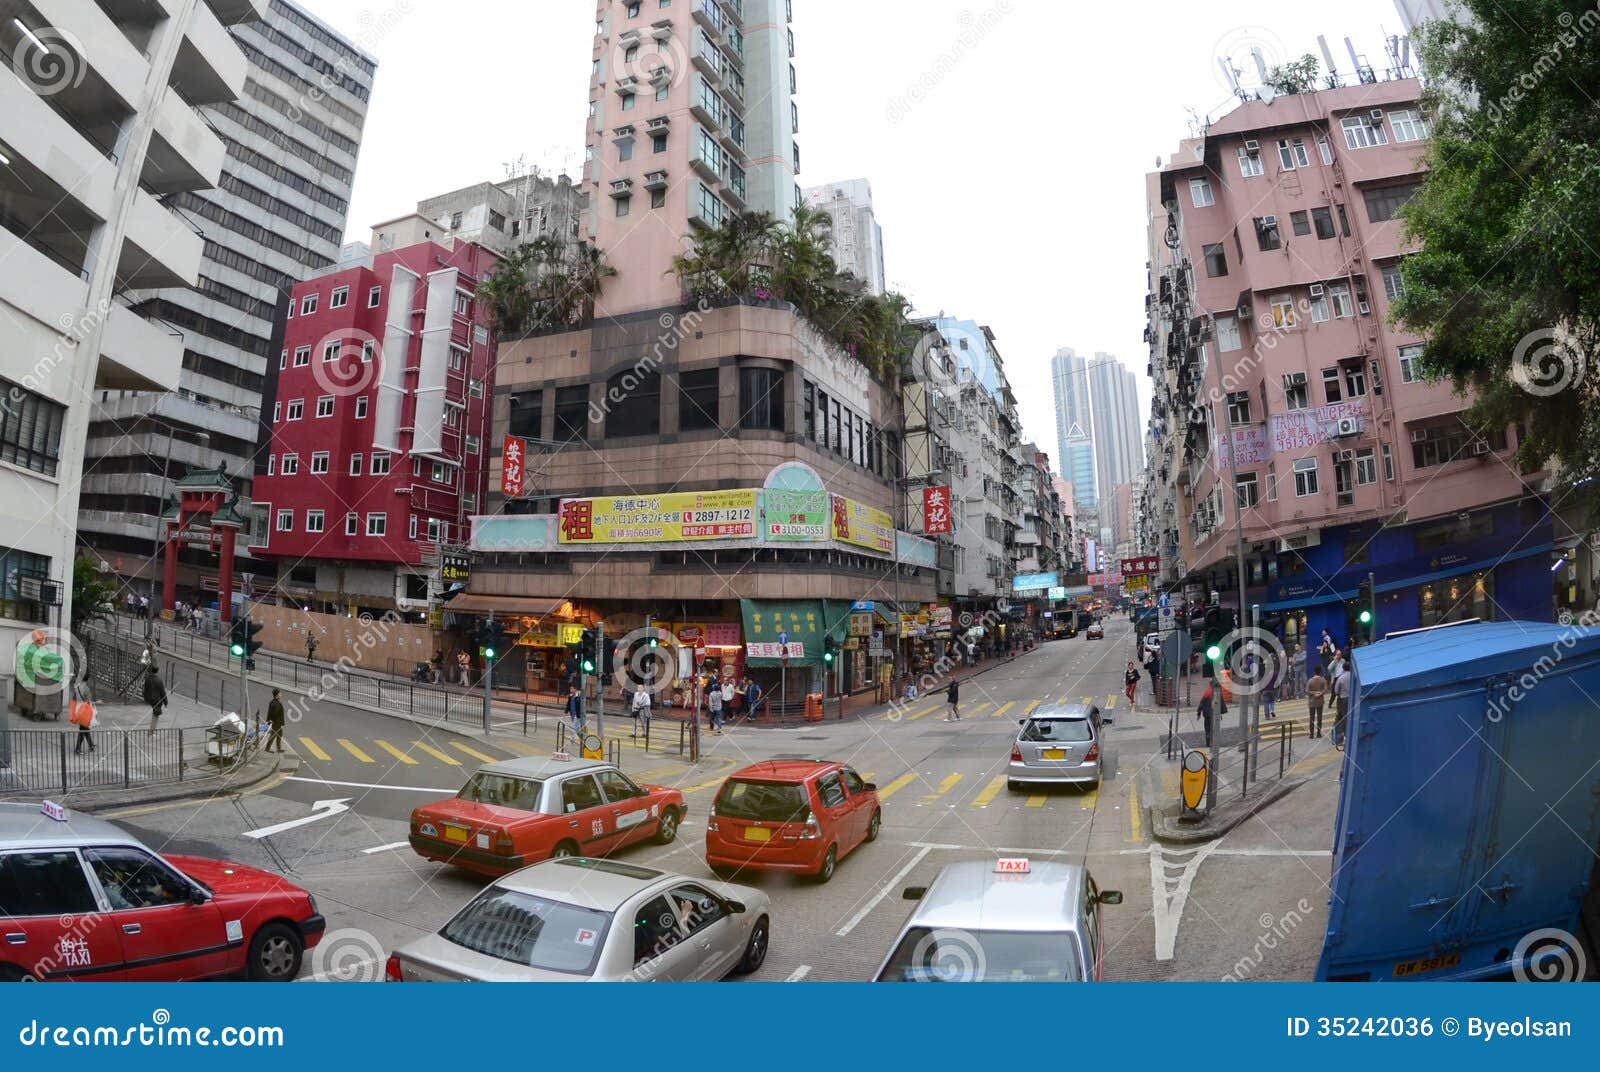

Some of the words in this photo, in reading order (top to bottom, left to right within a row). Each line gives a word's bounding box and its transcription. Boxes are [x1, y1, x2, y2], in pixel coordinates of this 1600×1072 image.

[506, 440, 521, 482] 安記
[613, 498, 660, 512] 海德中心
[928, 490, 947, 522] 安記
[562, 501, 593, 540] 租
[695, 509, 750, 522] 2897-1212
[999, 861, 1027, 870] TAXI
[579, 930, 593, 942] P
[61, 938, 88, 952] 的士
[62, 951, 91, 966] TAXI
